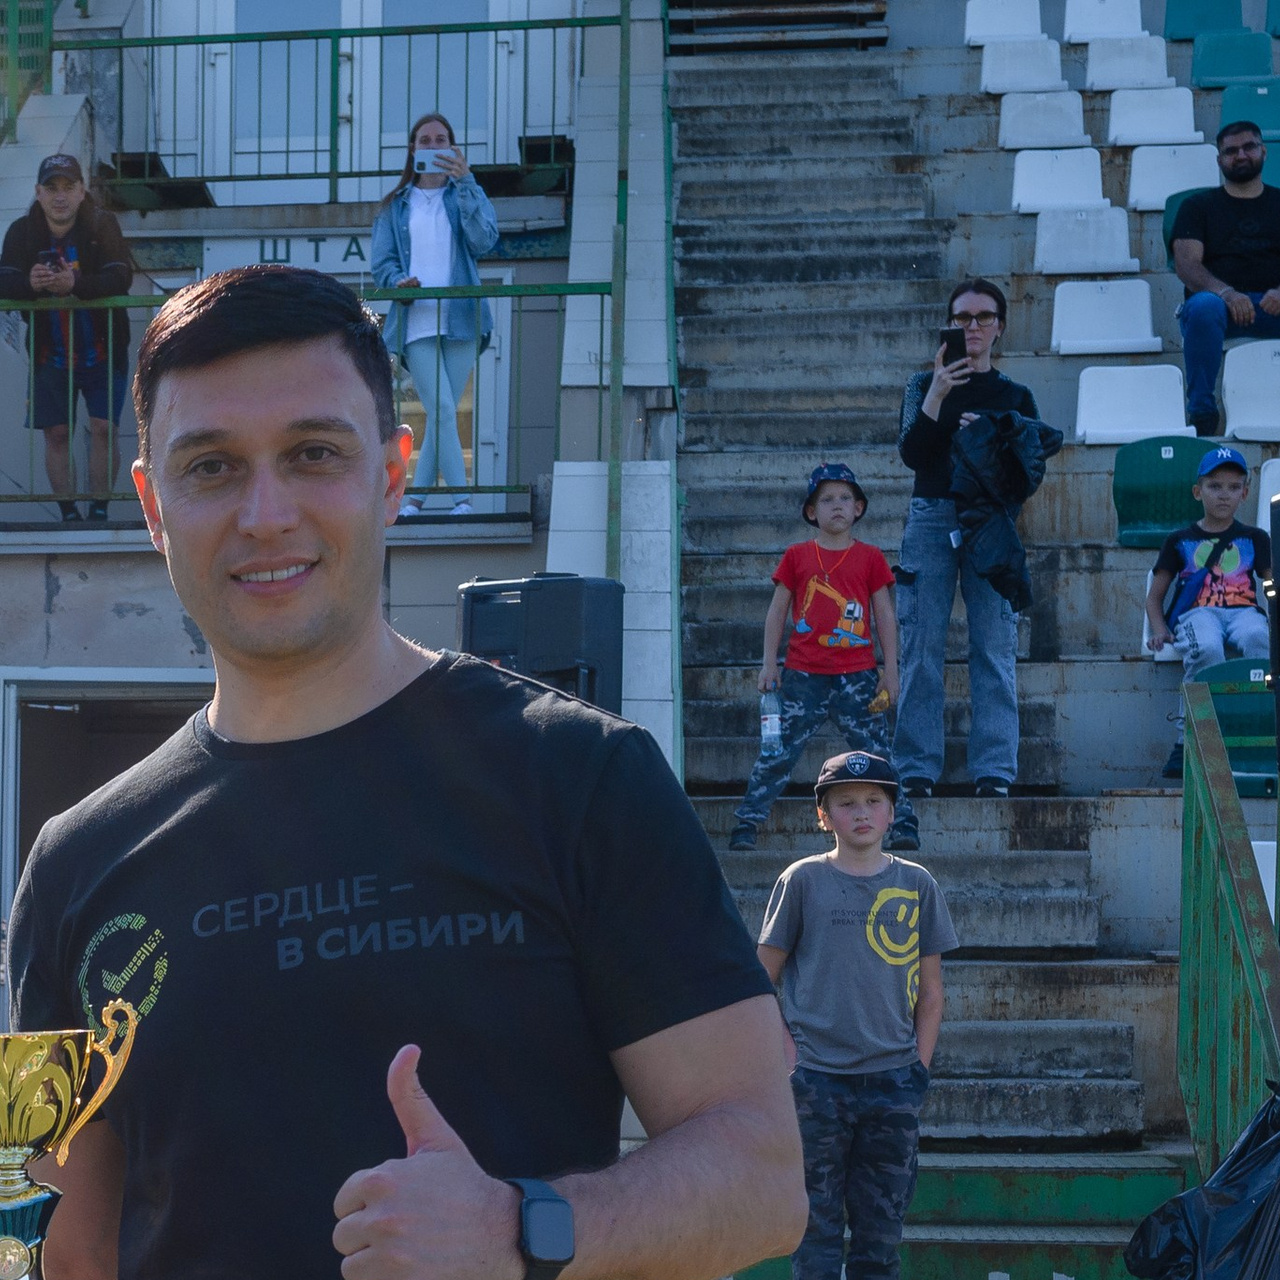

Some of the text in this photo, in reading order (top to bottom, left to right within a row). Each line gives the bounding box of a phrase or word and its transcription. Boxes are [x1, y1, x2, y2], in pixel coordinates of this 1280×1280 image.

[192, 874, 379, 937] СЕРДЦЕ
[277, 911, 525, 971] В СИБИРИ
